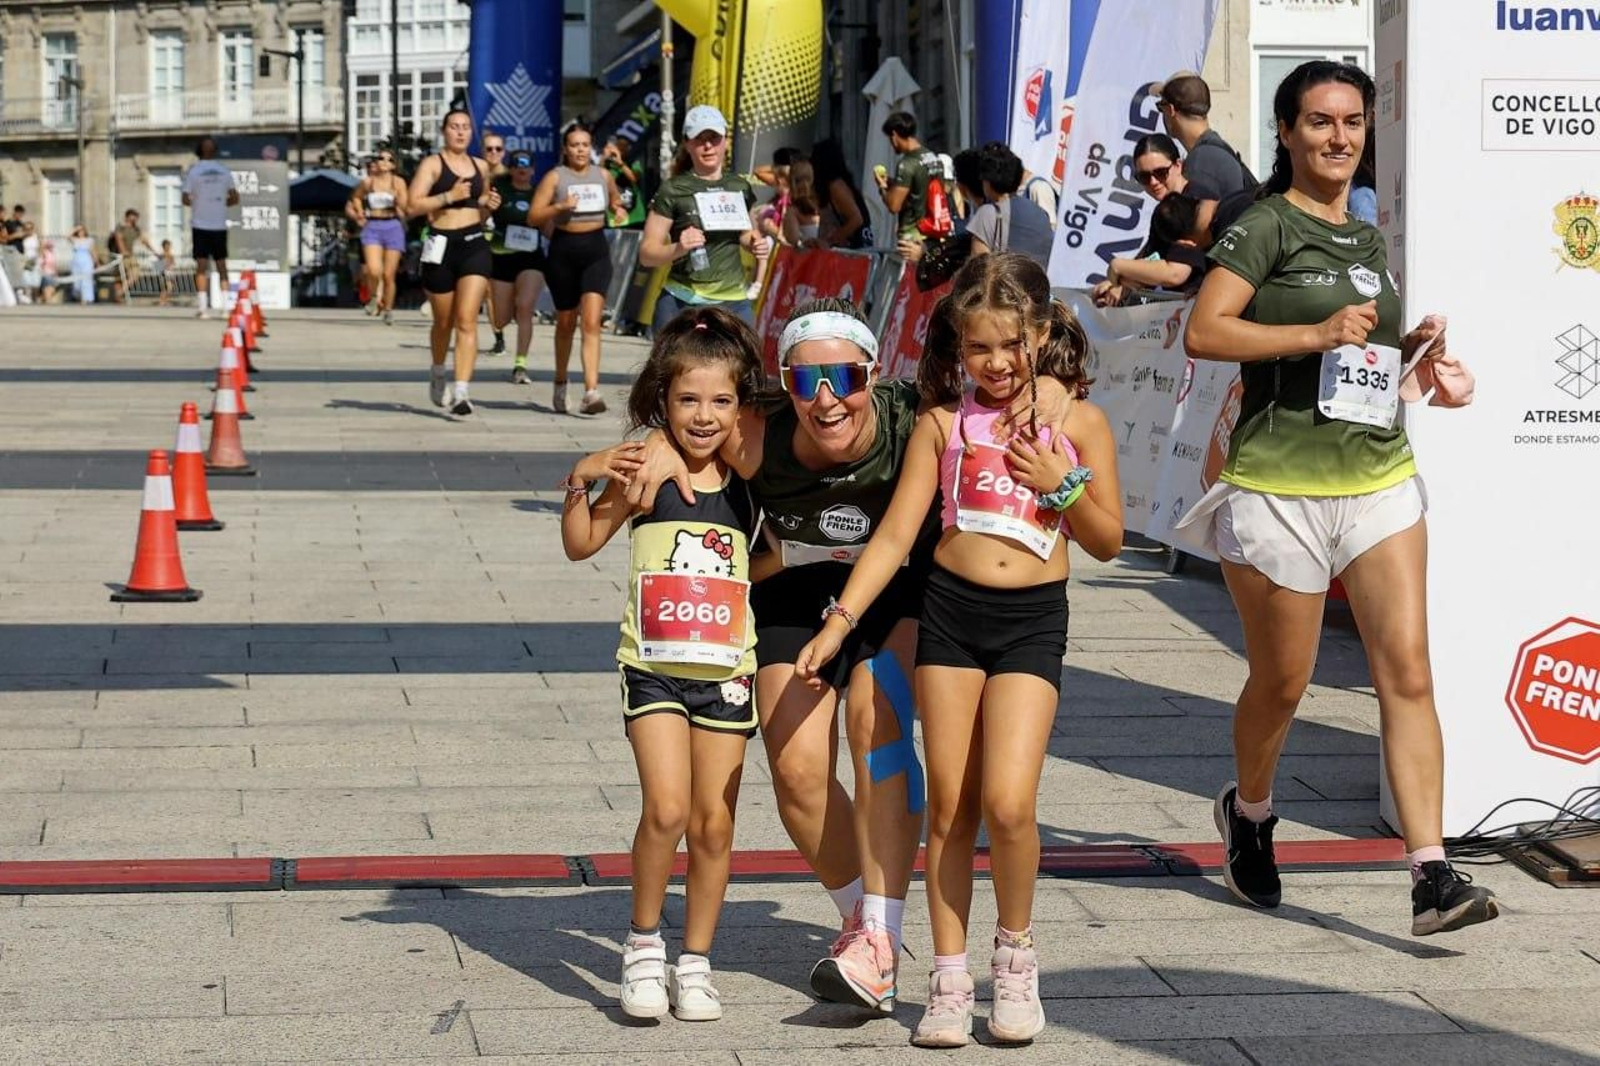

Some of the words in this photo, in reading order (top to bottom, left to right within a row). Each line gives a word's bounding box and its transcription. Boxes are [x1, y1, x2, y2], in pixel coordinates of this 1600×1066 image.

[1506, 118, 1534, 135] DE
[1542, 118, 1595, 135] VIGO
[505, 131, 554, 152] anvi
[1084, 142, 1111, 179] de
[242, 206, 280, 218] META
[710, 204, 736, 214] 1162
[1064, 187, 1103, 249] Vigo
[1340, 365, 1390, 391] 1335
[1514, 435, 1553, 444] DONDE
[825, 521, 862, 532] FRENO
[827, 514, 864, 525] PONLE
[658, 601, 731, 625] 2060
[1524, 680, 1600, 722] FREN
